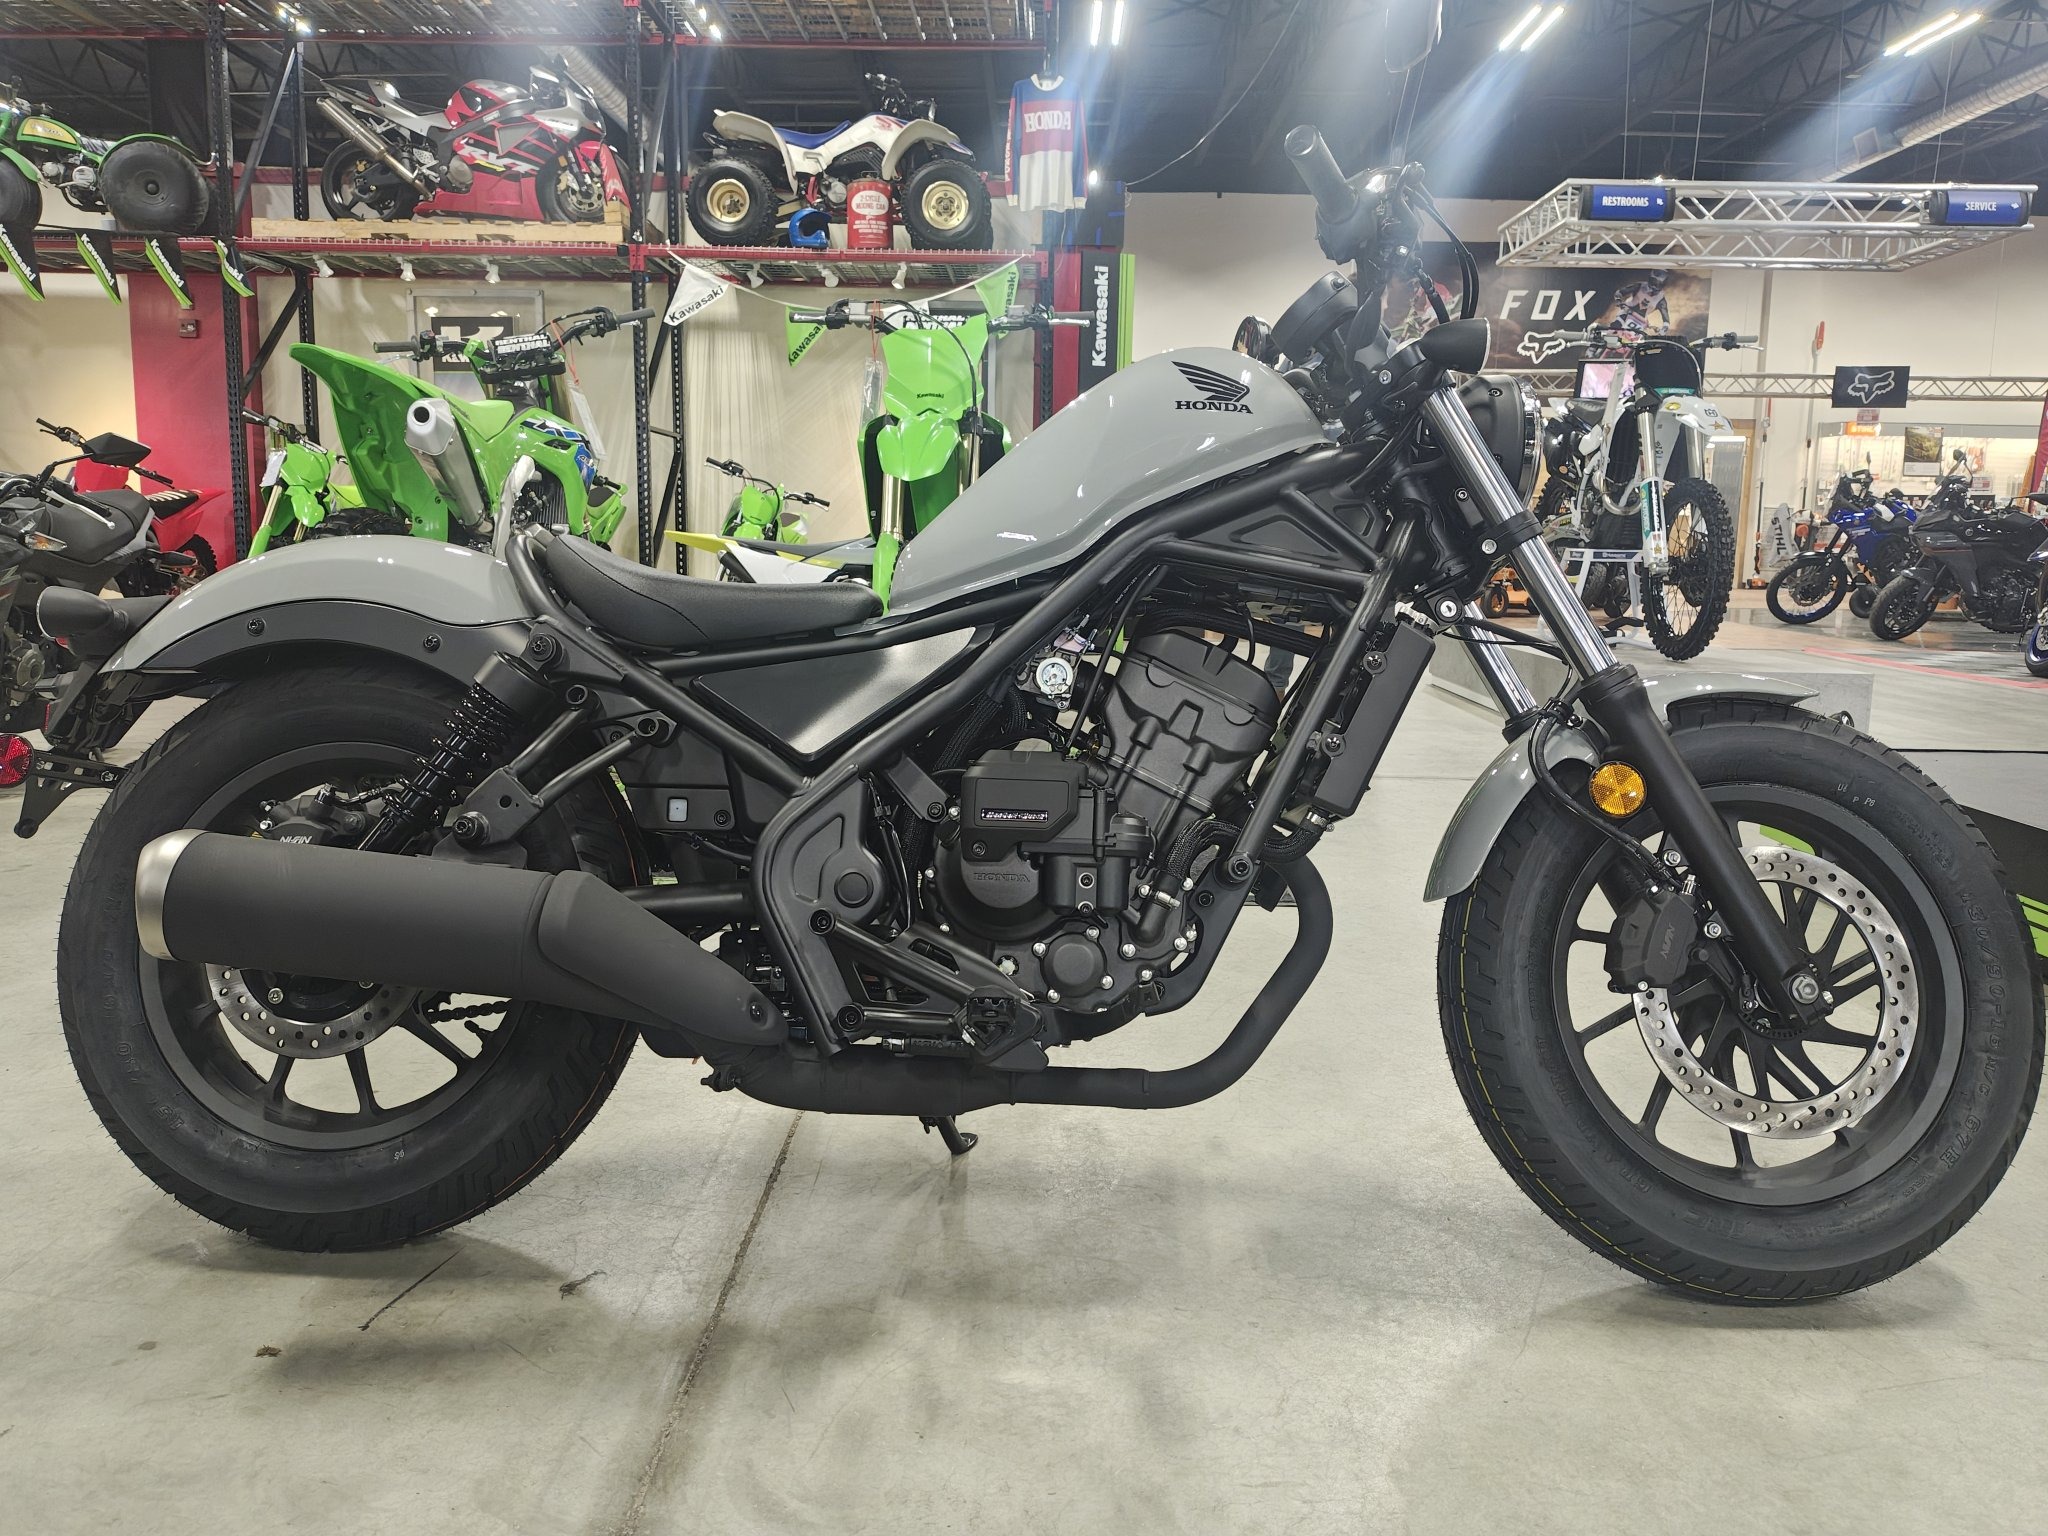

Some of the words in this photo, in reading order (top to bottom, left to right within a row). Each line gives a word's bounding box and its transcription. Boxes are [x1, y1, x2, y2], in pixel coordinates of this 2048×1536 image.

[1024, 110, 1072, 132] HONDA
[1602, 195, 1650, 208] RESTROOMS
[1964, 201, 1998, 212] SERVICE
[80, 232, 116, 287] Kawasaki
[150, 238, 185, 288] Kawasaki
[668, 285, 724, 323] Kawasaki
[1091, 265, 1109, 368] Kawasaki
[1500, 289, 1596, 321] FOX
[1174, 400, 1254, 415] HONDA
[1771, 516, 1787, 556] STIHL
[973, 872, 1031, 882] HONDA
[1940, 1114, 1982, 1169] 67H
